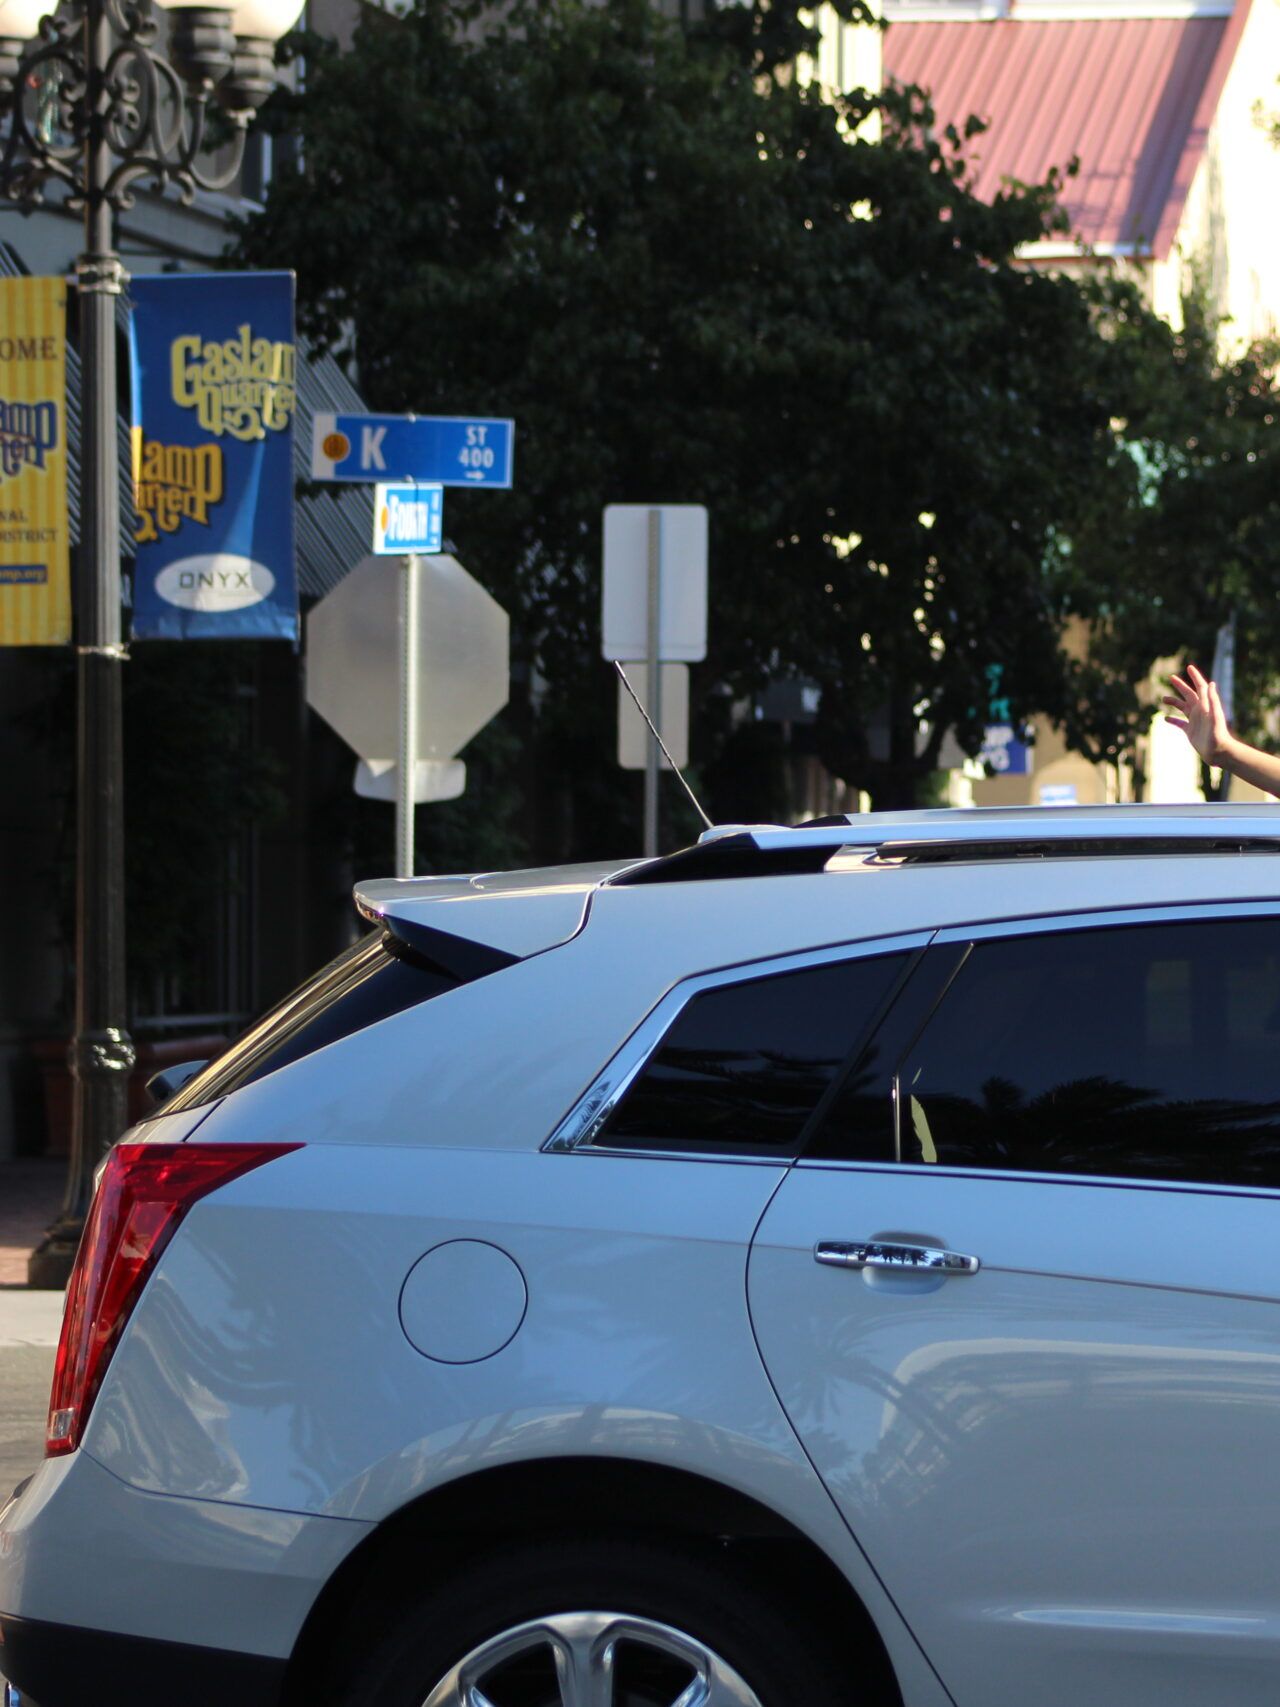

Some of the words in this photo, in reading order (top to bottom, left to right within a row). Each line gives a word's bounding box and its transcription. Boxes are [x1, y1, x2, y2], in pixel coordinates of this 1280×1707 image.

[0, 337, 57, 361] OME
[466, 426, 487, 446] ST
[361, 426, 387, 470] K
[459, 447, 494, 469] 400
[180, 572, 249, 588] ONYX
